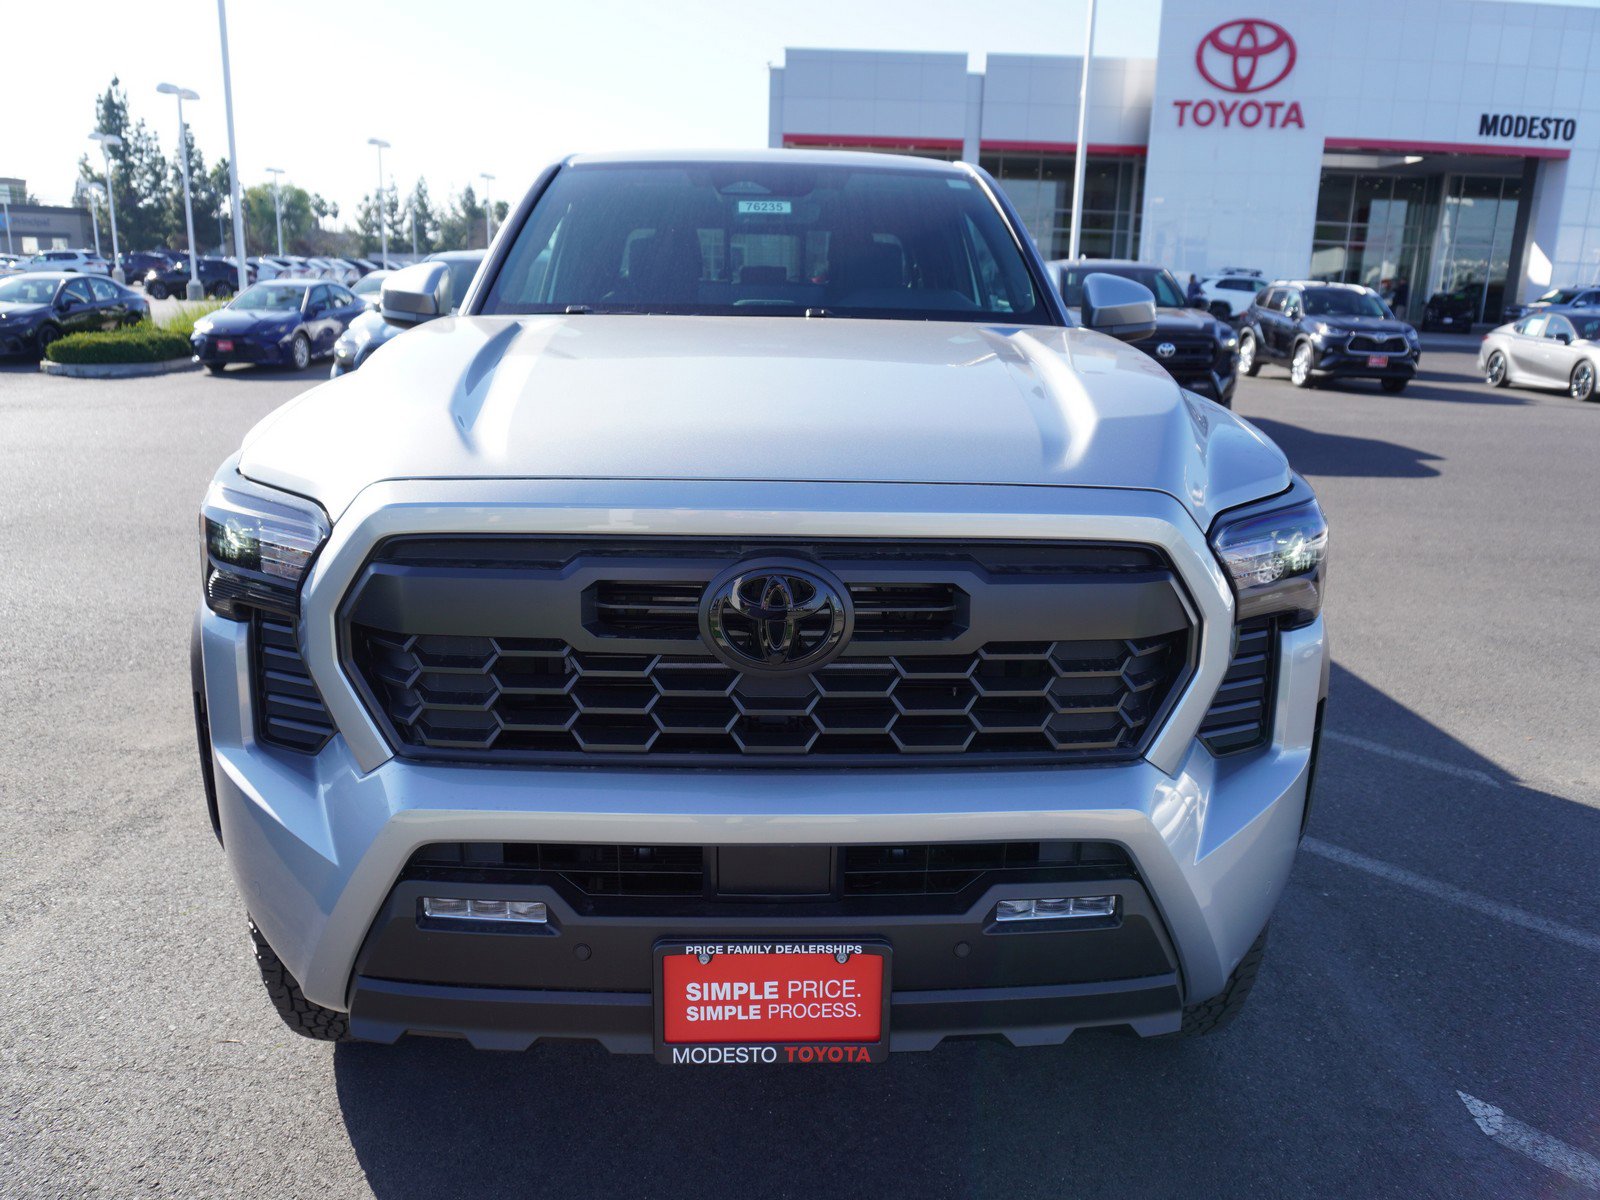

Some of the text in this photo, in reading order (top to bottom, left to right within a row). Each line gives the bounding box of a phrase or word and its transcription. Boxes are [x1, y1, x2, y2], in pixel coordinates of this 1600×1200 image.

[1173, 99, 1305, 129] TOYOTA
[1478, 113, 1577, 141] MODESTO
[746, 202, 783, 212] 76235
[685, 944, 863, 955] PRICE FAMILY DEALERSHIPS
[685, 979, 861, 1001] SIMPLE PRICE.
[685, 1002, 861, 1022] SIMPLE PROCESS.
[672, 1046, 871, 1064] MODESTO TOYOTA
